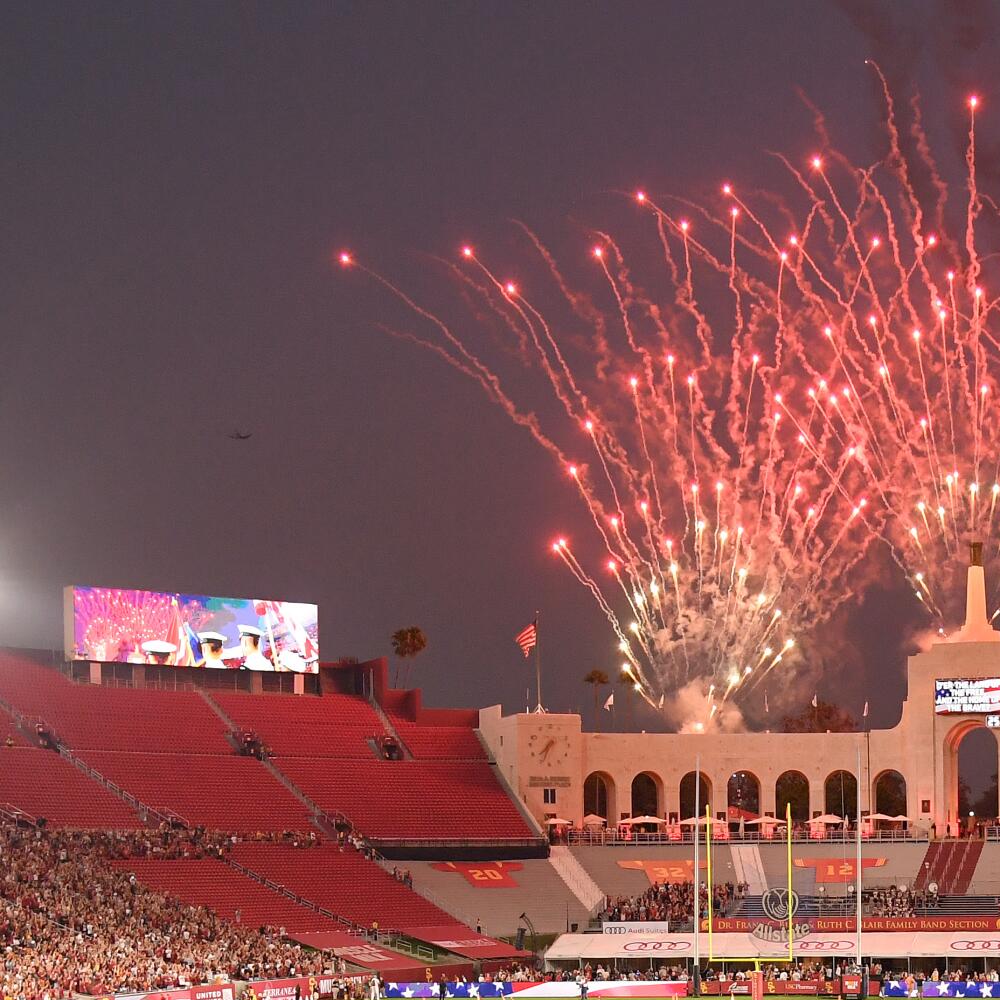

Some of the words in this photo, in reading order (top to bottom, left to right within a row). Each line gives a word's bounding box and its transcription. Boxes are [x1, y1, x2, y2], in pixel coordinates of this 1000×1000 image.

[468, 869, 503, 880] 20
[653, 867, 686, 878] 32
[825, 864, 853, 875] 12
[817, 920, 842, 929] RUTH
[885, 920, 917, 929] FAMILY
[920, 920, 946, 929] BAND
[949, 920, 989, 929] SECTION
[752, 922, 810, 943] Allstate
[196, 991, 221, 999] UNITED
